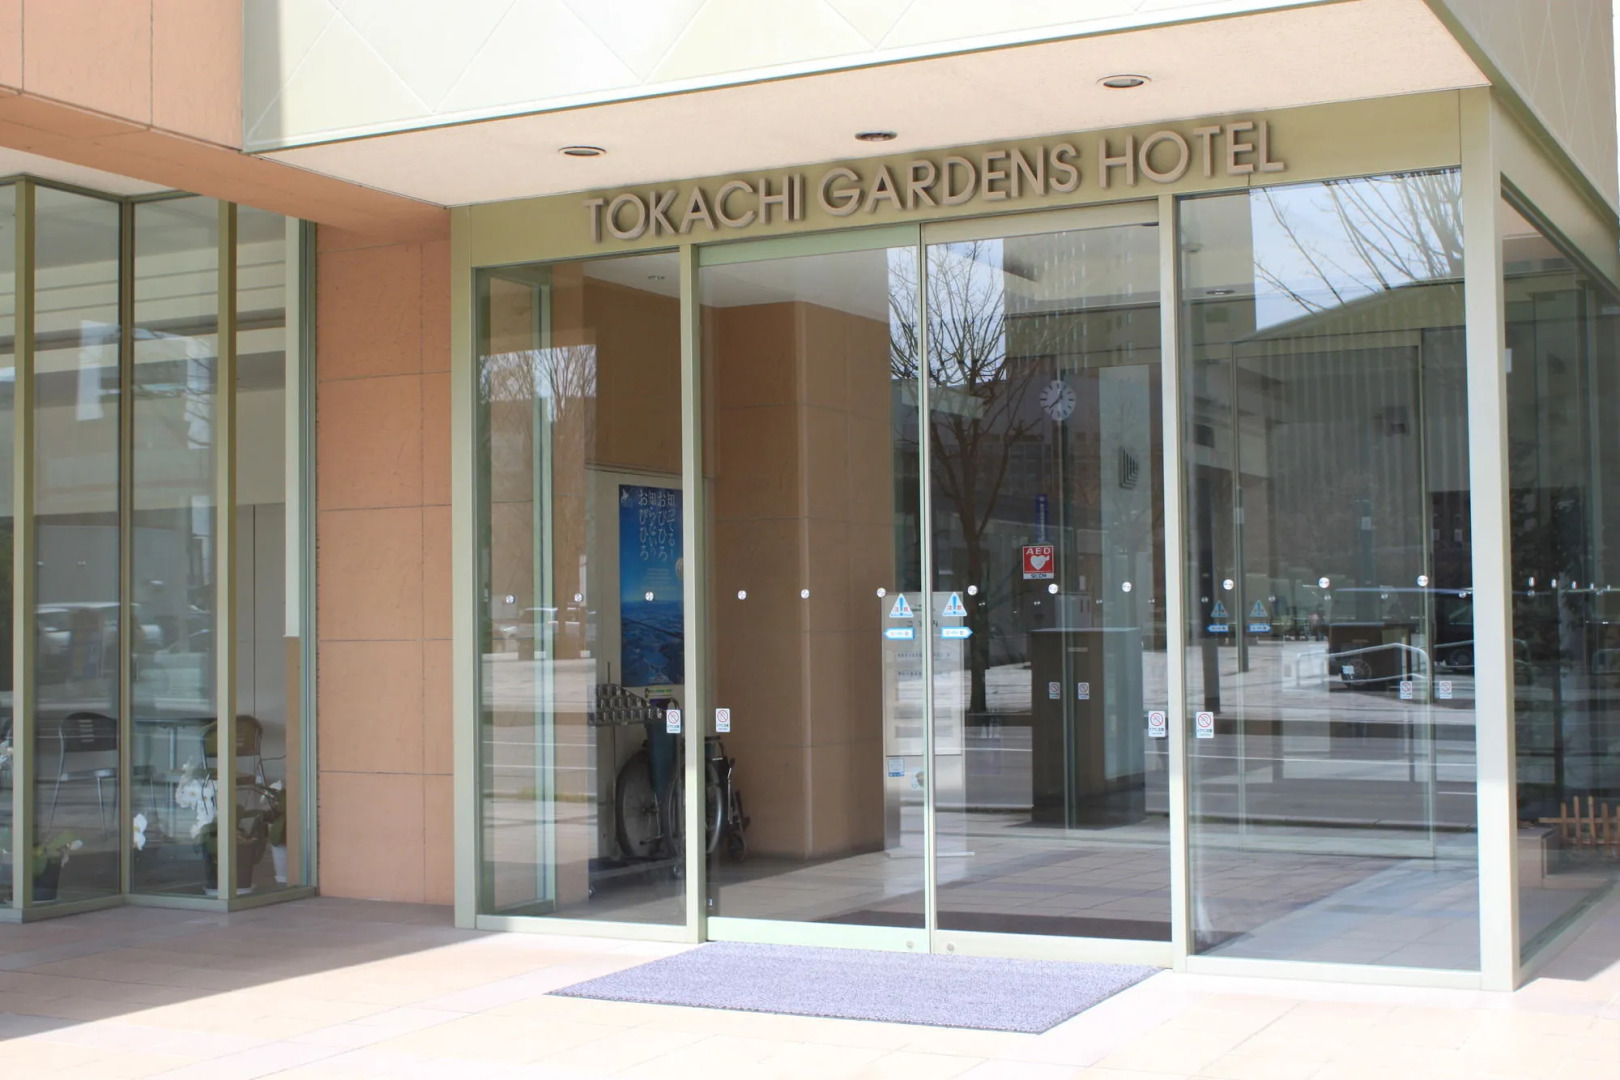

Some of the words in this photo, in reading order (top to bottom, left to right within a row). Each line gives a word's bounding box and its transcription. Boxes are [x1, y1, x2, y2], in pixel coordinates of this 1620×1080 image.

[581, 174, 801, 243] TOKACHI
[817, 143, 1079, 217] GARDENS
[1099, 121, 1286, 188] HOTEL
[638, 488, 649, 561] おびひろ
[657, 491, 668, 562] おびひろ
[1025, 547, 1051, 555] AED
